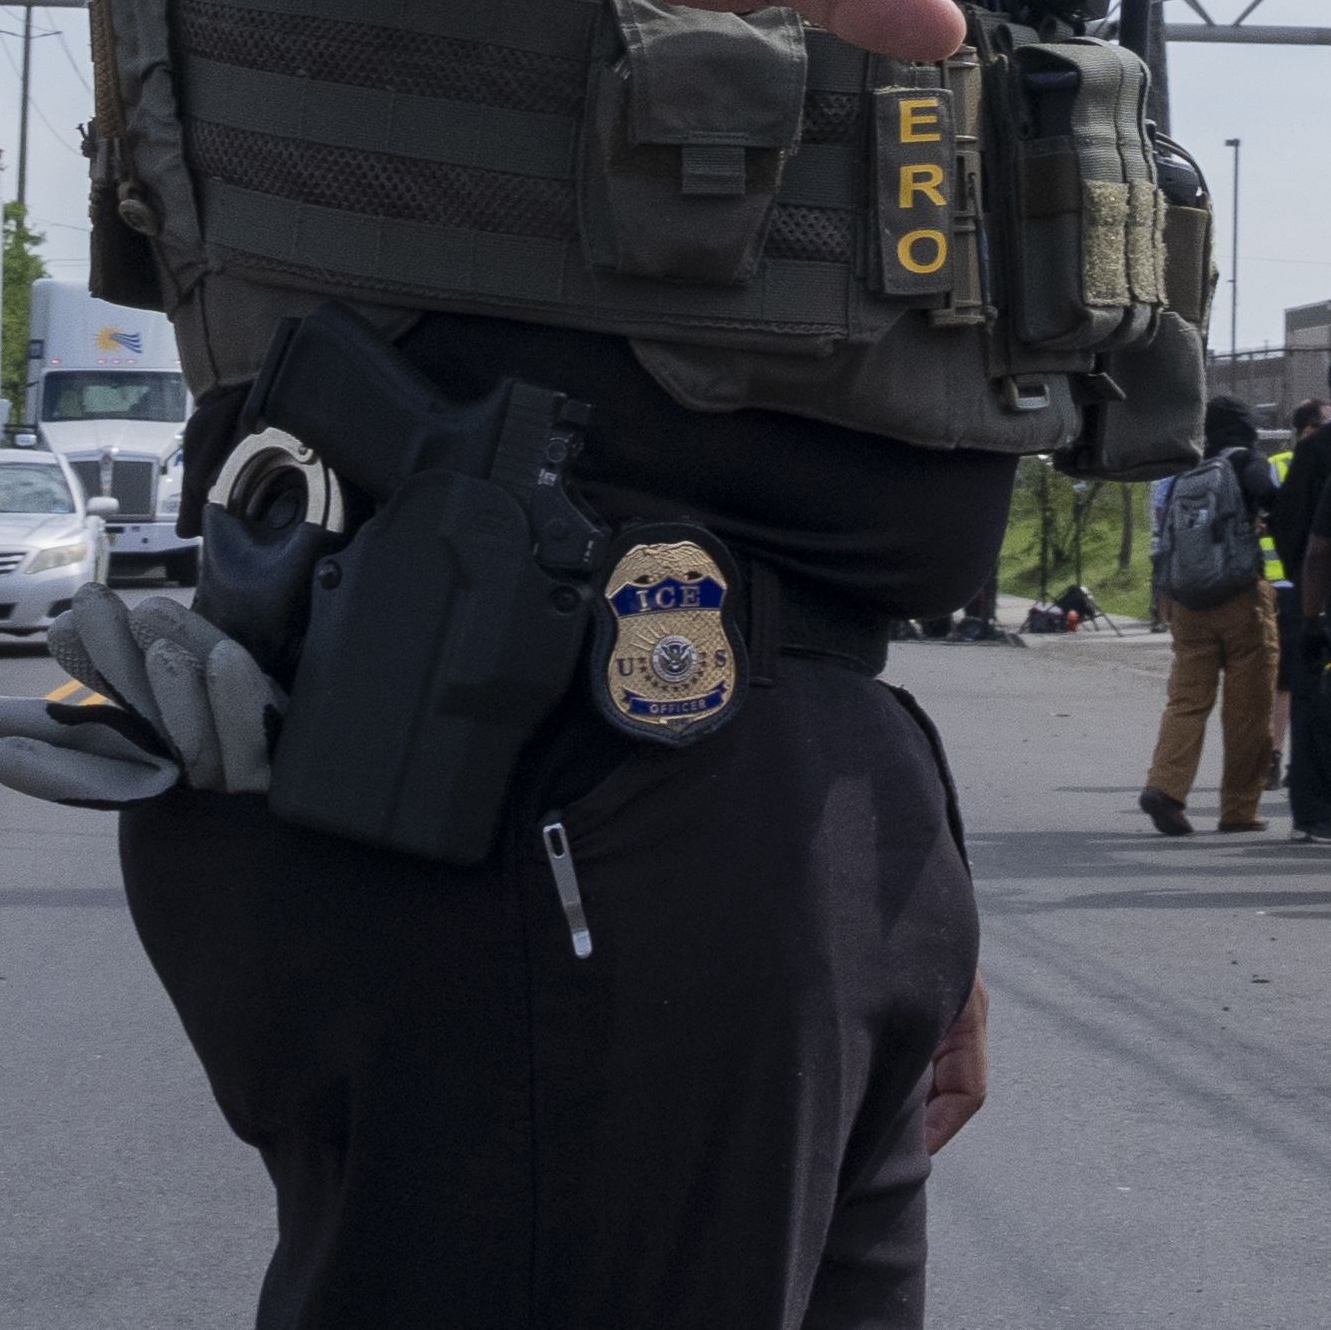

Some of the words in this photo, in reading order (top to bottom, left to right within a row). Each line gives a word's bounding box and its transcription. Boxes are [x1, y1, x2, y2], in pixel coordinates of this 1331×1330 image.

[897, 99, 947, 274] ERO
[635, 586, 701, 612] ICE
[616, 657, 635, 677] U
[714, 649, 728, 668] S
[649, 699, 707, 714] OFFICER
